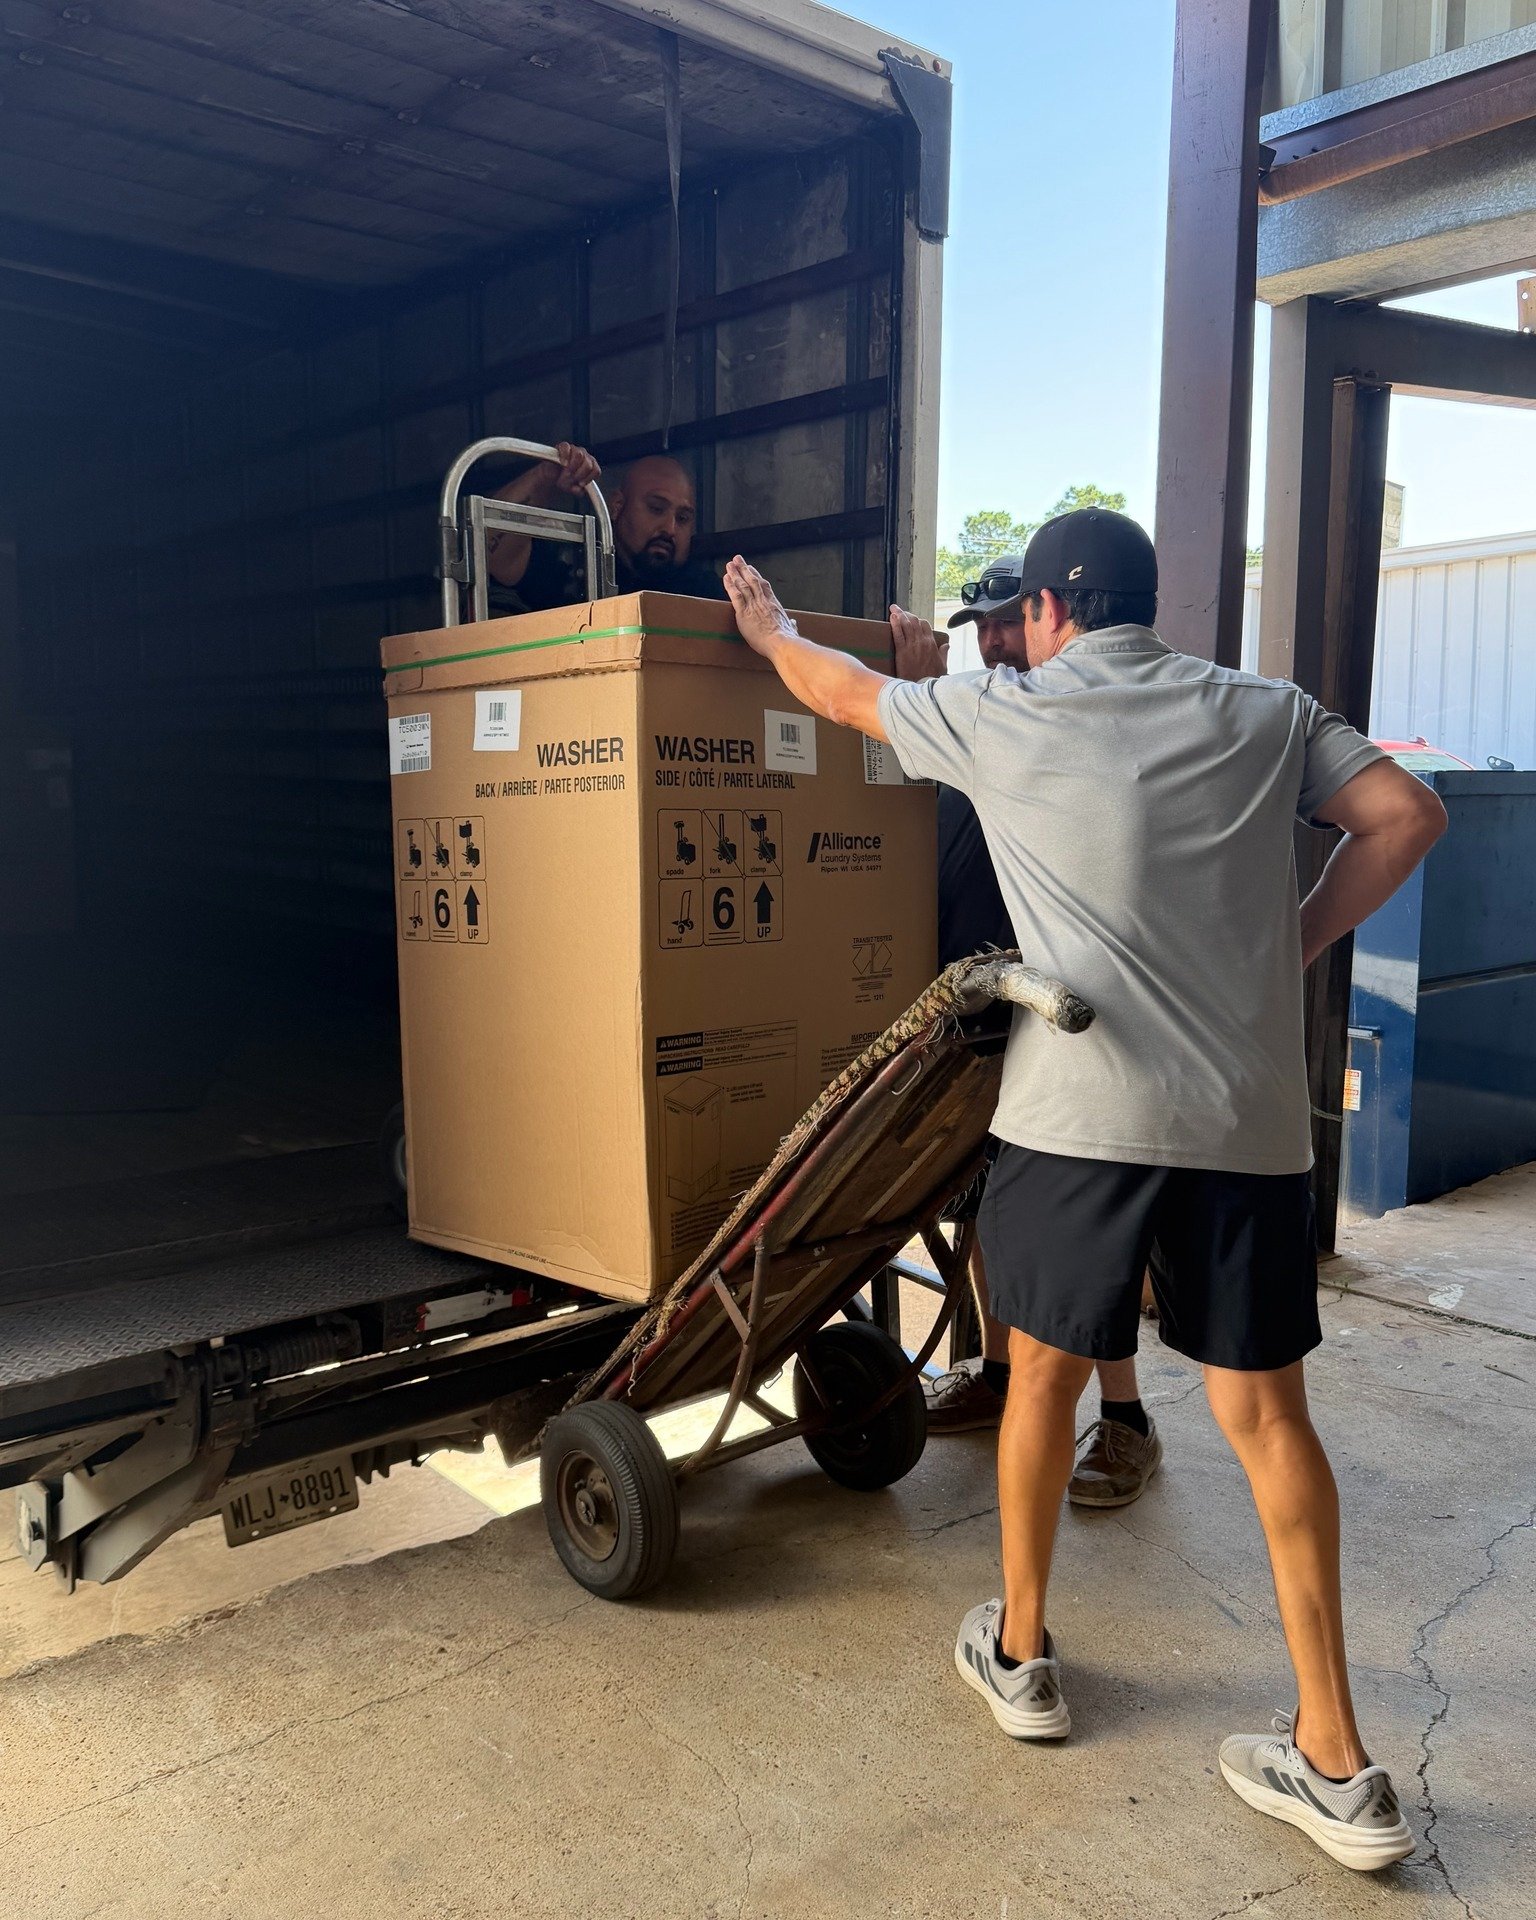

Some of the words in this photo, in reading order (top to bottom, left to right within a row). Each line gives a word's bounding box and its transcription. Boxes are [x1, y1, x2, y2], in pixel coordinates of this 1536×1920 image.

[537, 736, 624, 768] WASHER
[655, 735, 755, 764] WASHER
[475, 782, 496, 799] BACK
[502, 776, 538, 797] ARRIÈRE
[544, 777, 572, 794] PARTE
[574, 774, 626, 793] POSTERIOR
[655, 770, 680, 787] SIDE
[689, 768, 715, 787] CÔTÉ
[724, 773, 755, 788] PARTE
[756, 773, 796, 789] LATERAL
[821, 832, 881, 850] Alliance
[820, 854, 850, 864] Laundry
[852, 853, 882, 864] Systems
[820, 866, 838, 874] Ripon
[434, 888, 450, 928] 6
[713, 886, 735, 930] 6
[467, 928, 479, 940] UP
[757, 926, 771, 938] UP
[667, 1036, 702, 1047] WARNING
[851, 1031, 883, 1042] IMPORTA
[667, 1060, 701, 1072] WARNING
[230, 1486, 276, 1529] WLJ
[290, 1466, 350, 1510] 8891
